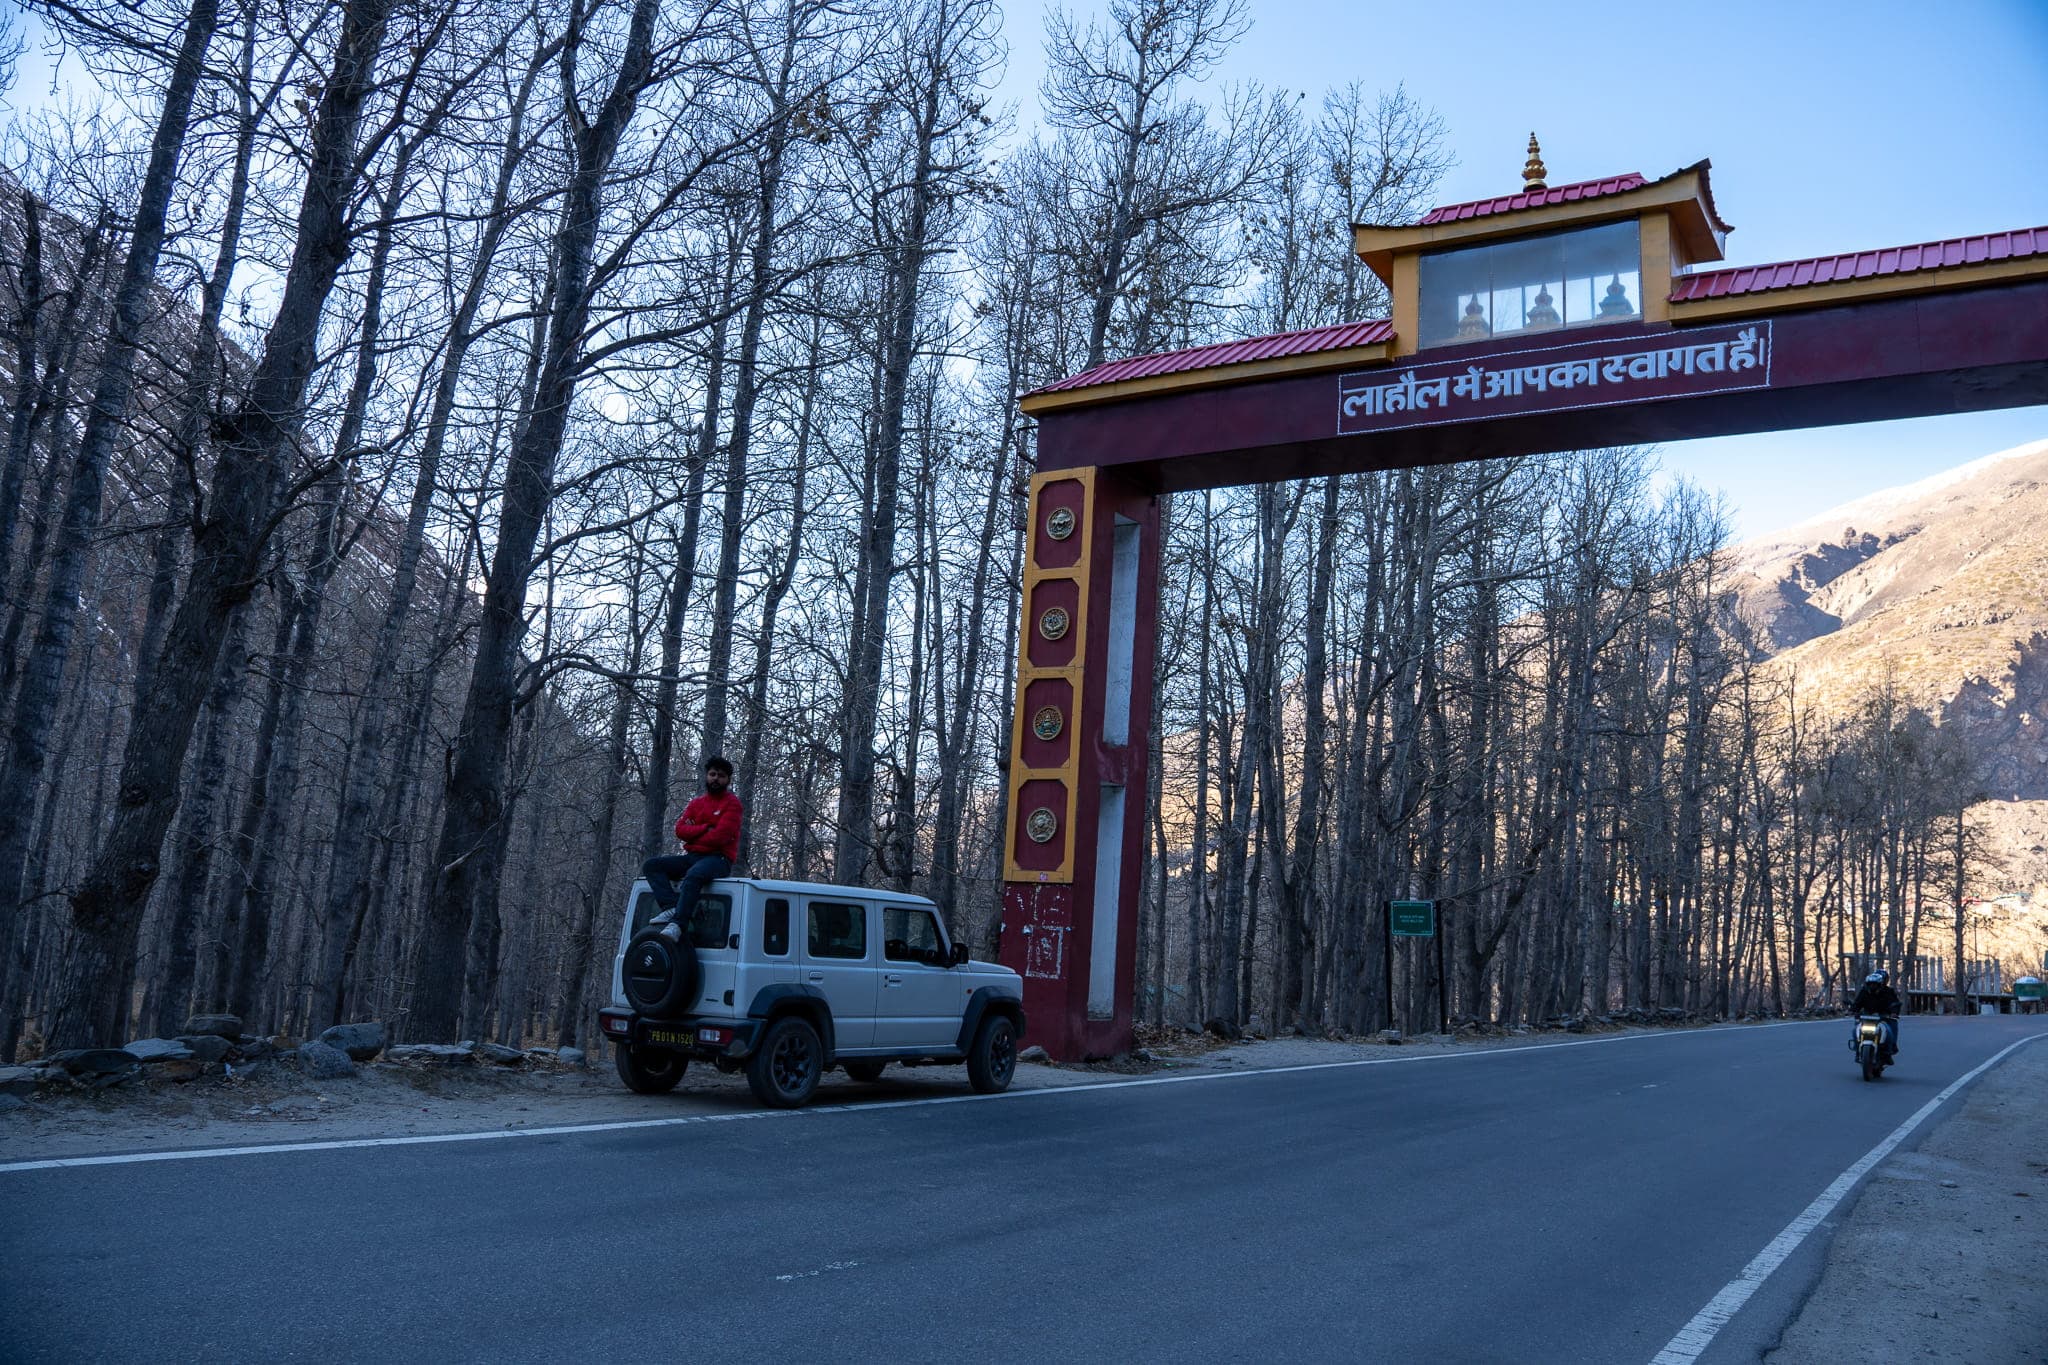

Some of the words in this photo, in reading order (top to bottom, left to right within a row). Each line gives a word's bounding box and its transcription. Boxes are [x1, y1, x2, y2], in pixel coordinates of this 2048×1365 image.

[1342, 370, 1449, 417] लाहौल
[1452, 366, 1483, 400] में
[1484, 357, 1599, 398] आपका
[1601, 341, 1728, 382] स्वागत
